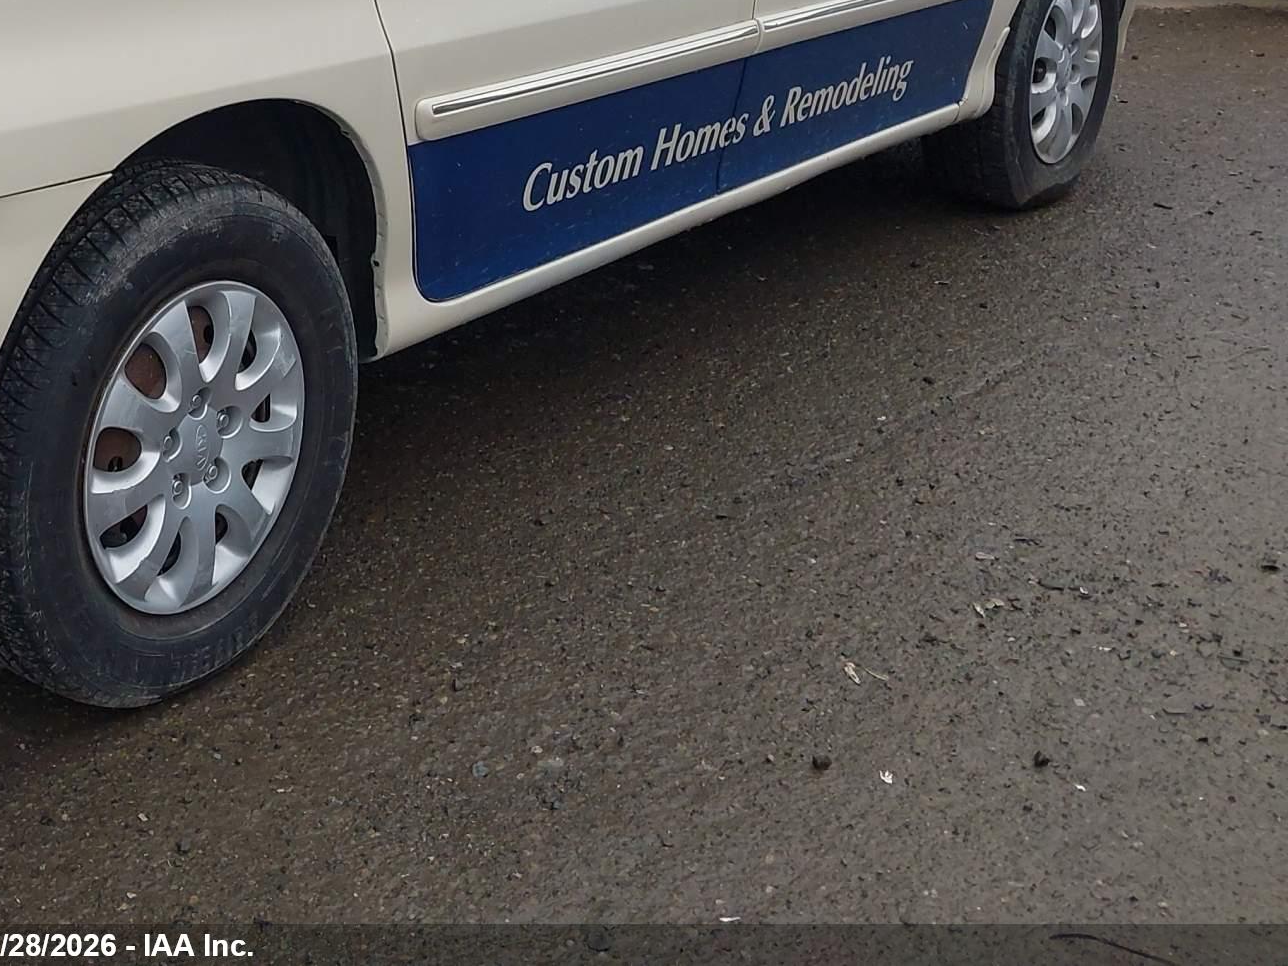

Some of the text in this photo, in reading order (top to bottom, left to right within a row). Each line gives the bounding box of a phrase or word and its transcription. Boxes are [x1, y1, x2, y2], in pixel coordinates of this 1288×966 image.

[522, 54, 914, 212] Custom Homes & Remodeling
